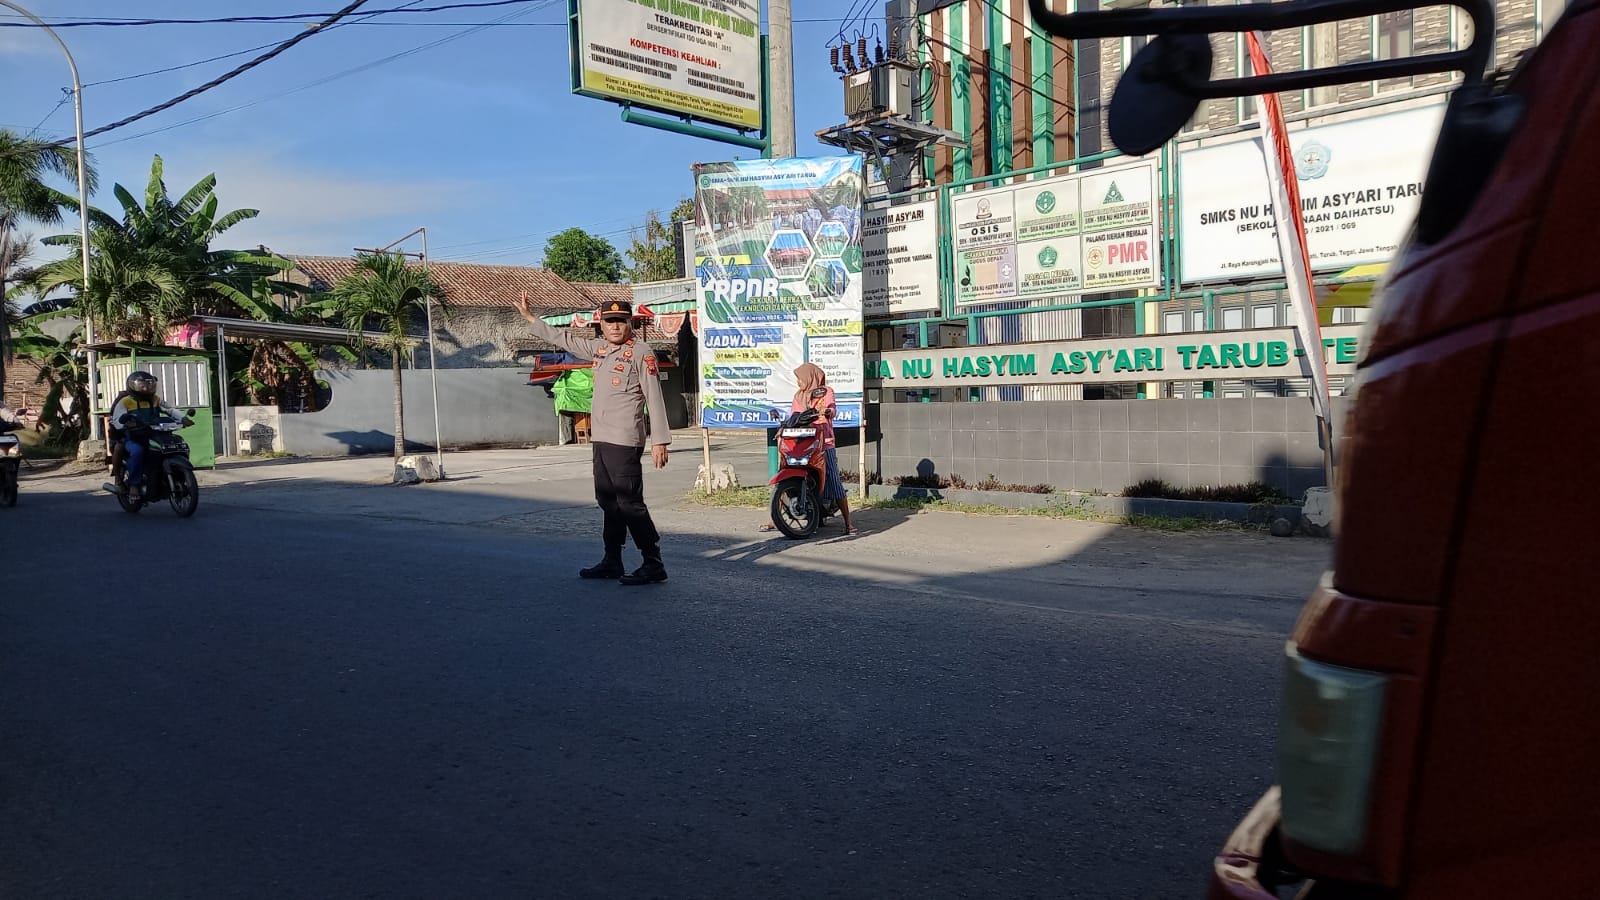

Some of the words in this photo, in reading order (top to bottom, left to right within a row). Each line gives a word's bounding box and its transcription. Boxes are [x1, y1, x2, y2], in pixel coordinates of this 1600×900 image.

[655, 14, 713, 37] TERAKREDITASI
[630, 38, 679, 58] KOMPETENSI
[680, 53, 718, 68] KEAHLIAN
[1200, 208, 1237, 226] SMKS
[1240, 205, 1260, 220] NU
[1322, 187, 1382, 209] ASY'ARI
[1386, 181, 1425, 200] TARU
[867, 214, 894, 227] HASYIM
[895, 209, 925, 223] ASY'ARI
[1334, 204, 1395, 220] DAIHATSU)
[971, 224, 999, 236] OSIS
[1125, 228, 1148, 239] REMAJA
[1315, 224, 1335, 234] 2021
[1107, 240, 1149, 265] PMR
[1241, 257, 1269, 267] Karangjati
[817, 318, 849, 328] SYARAT
[705, 334, 758, 348] JADWAL
[615, 357, 633, 366] POLRI
[902, 357, 934, 381] NU
[943, 353, 1037, 380] HASYIM
[1050, 346, 1164, 377] ASY'ARI
[714, 411, 734, 422] TKR
[740, 411, 761, 422] TSM
